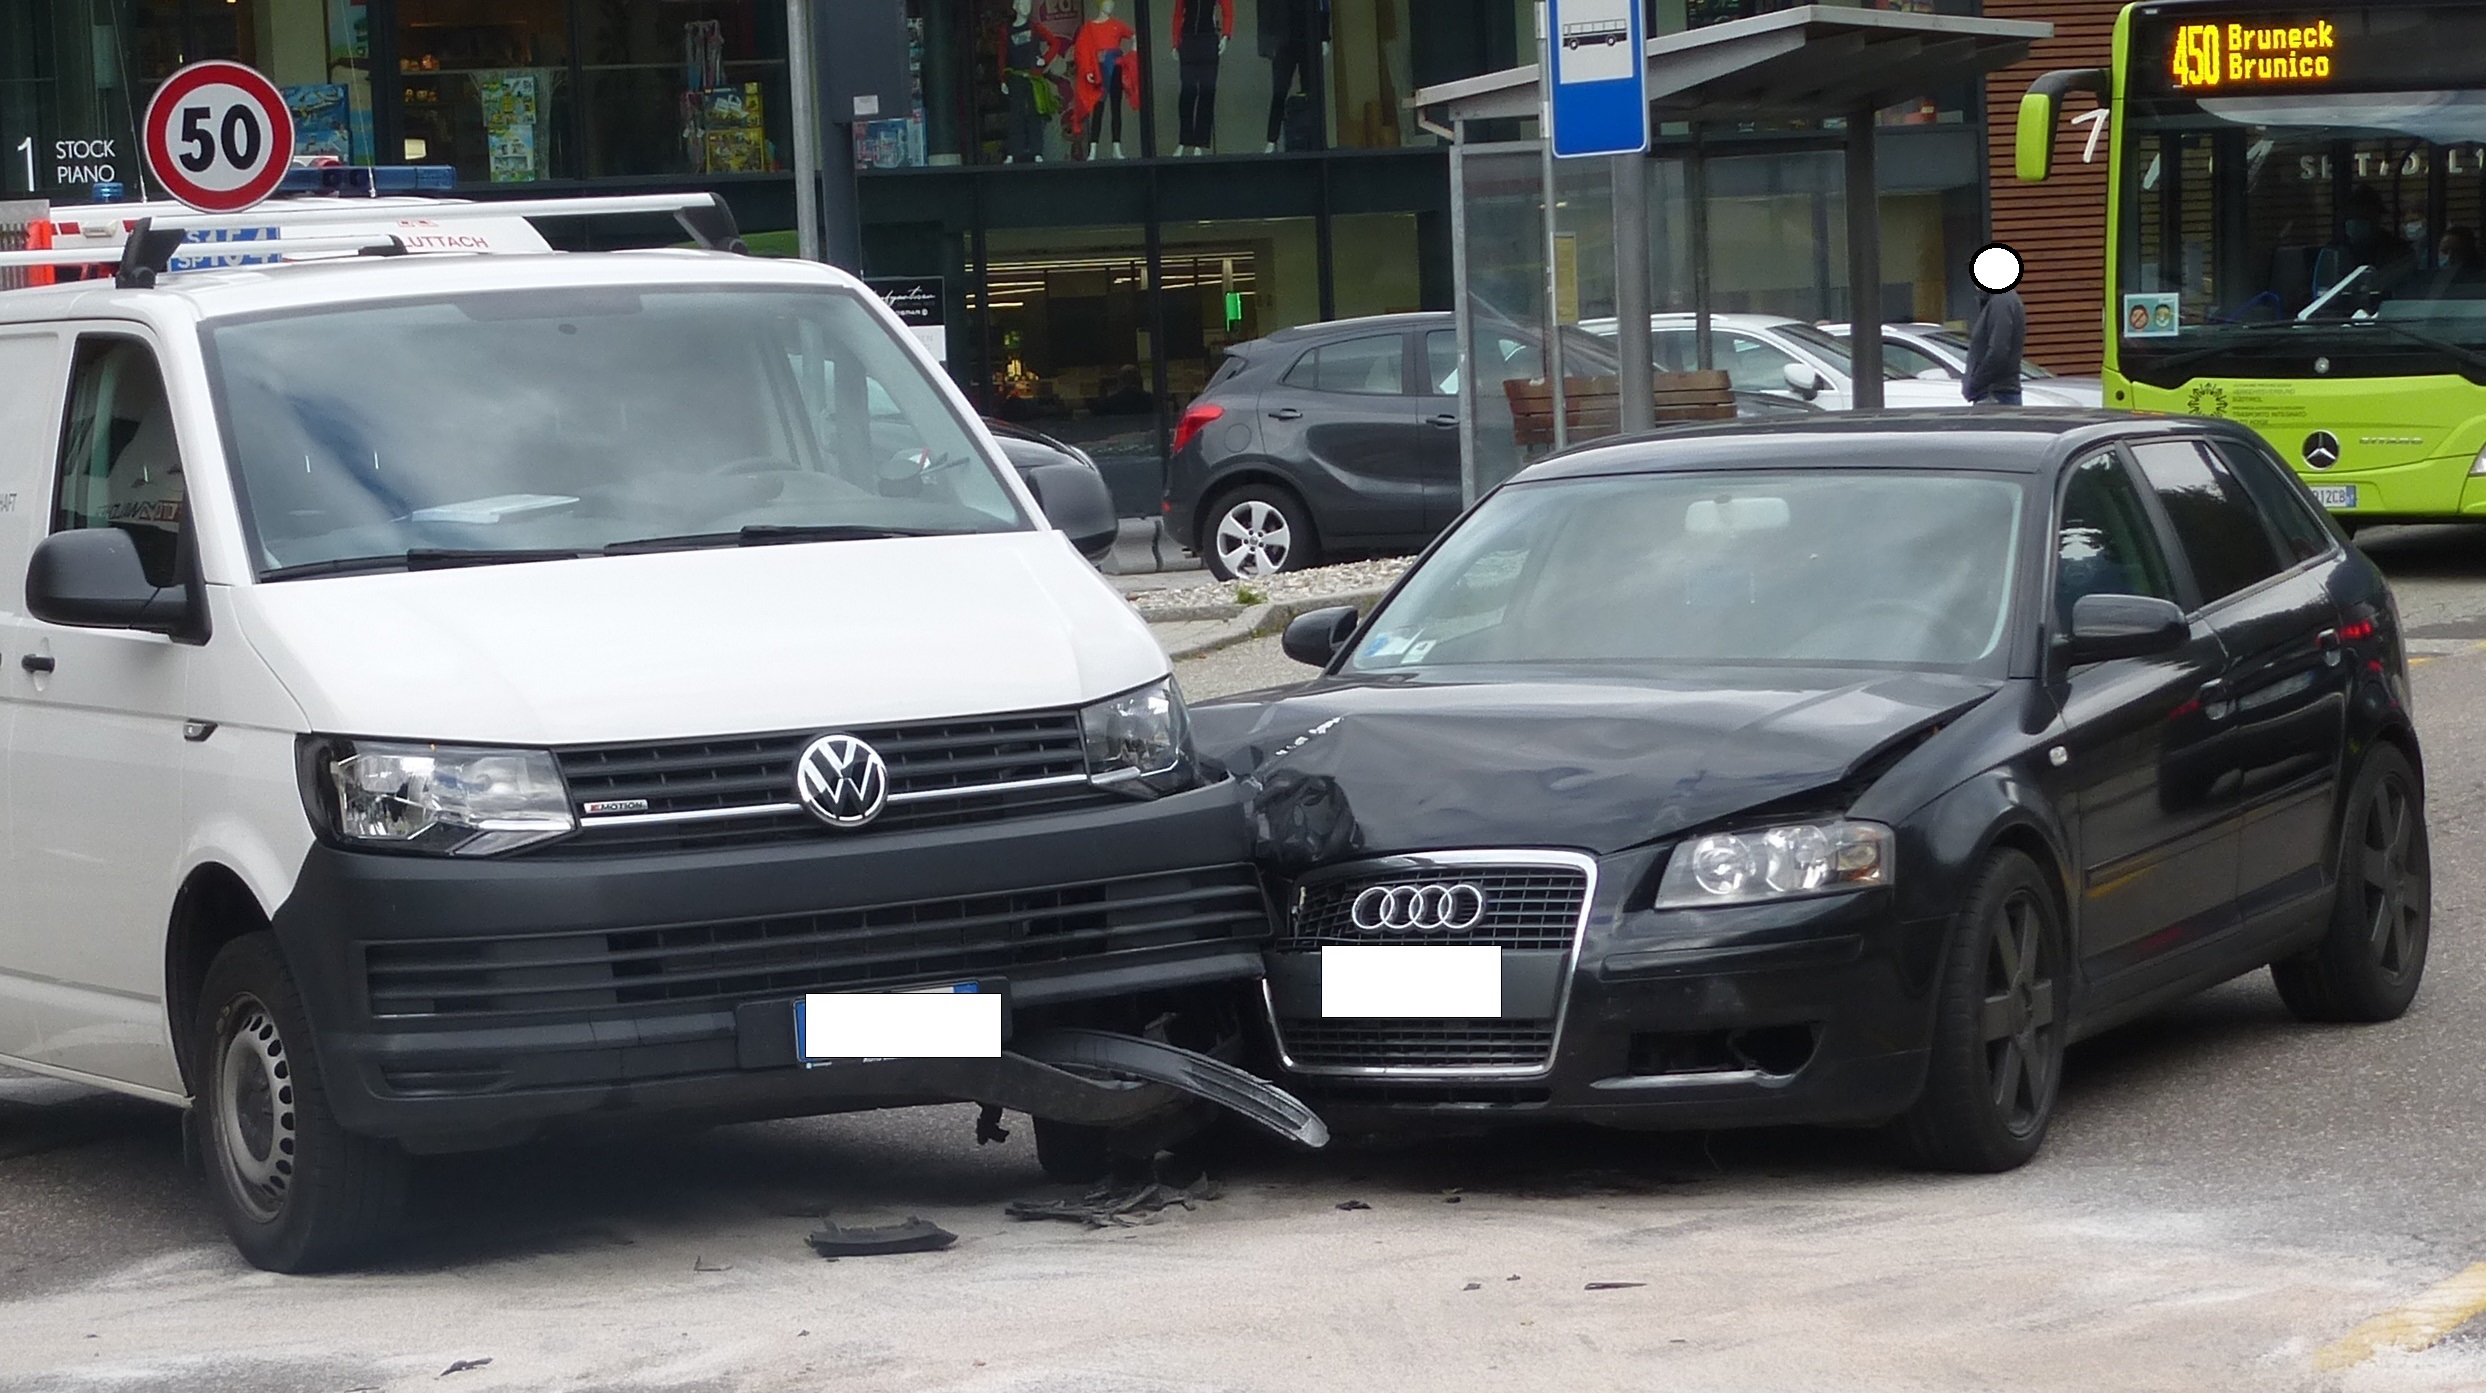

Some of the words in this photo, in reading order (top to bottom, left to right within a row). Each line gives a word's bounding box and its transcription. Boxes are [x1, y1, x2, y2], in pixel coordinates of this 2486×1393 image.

[2228, 20, 2334, 51] Bruneck
[2173, 25, 2220, 86] 450
[2229, 50, 2330, 80] Brunico
[55, 139, 116, 159] STOCK
[179, 104, 262, 172] 50
[17, 136, 35, 192] 1
[57, 164, 115, 184] PIANO
